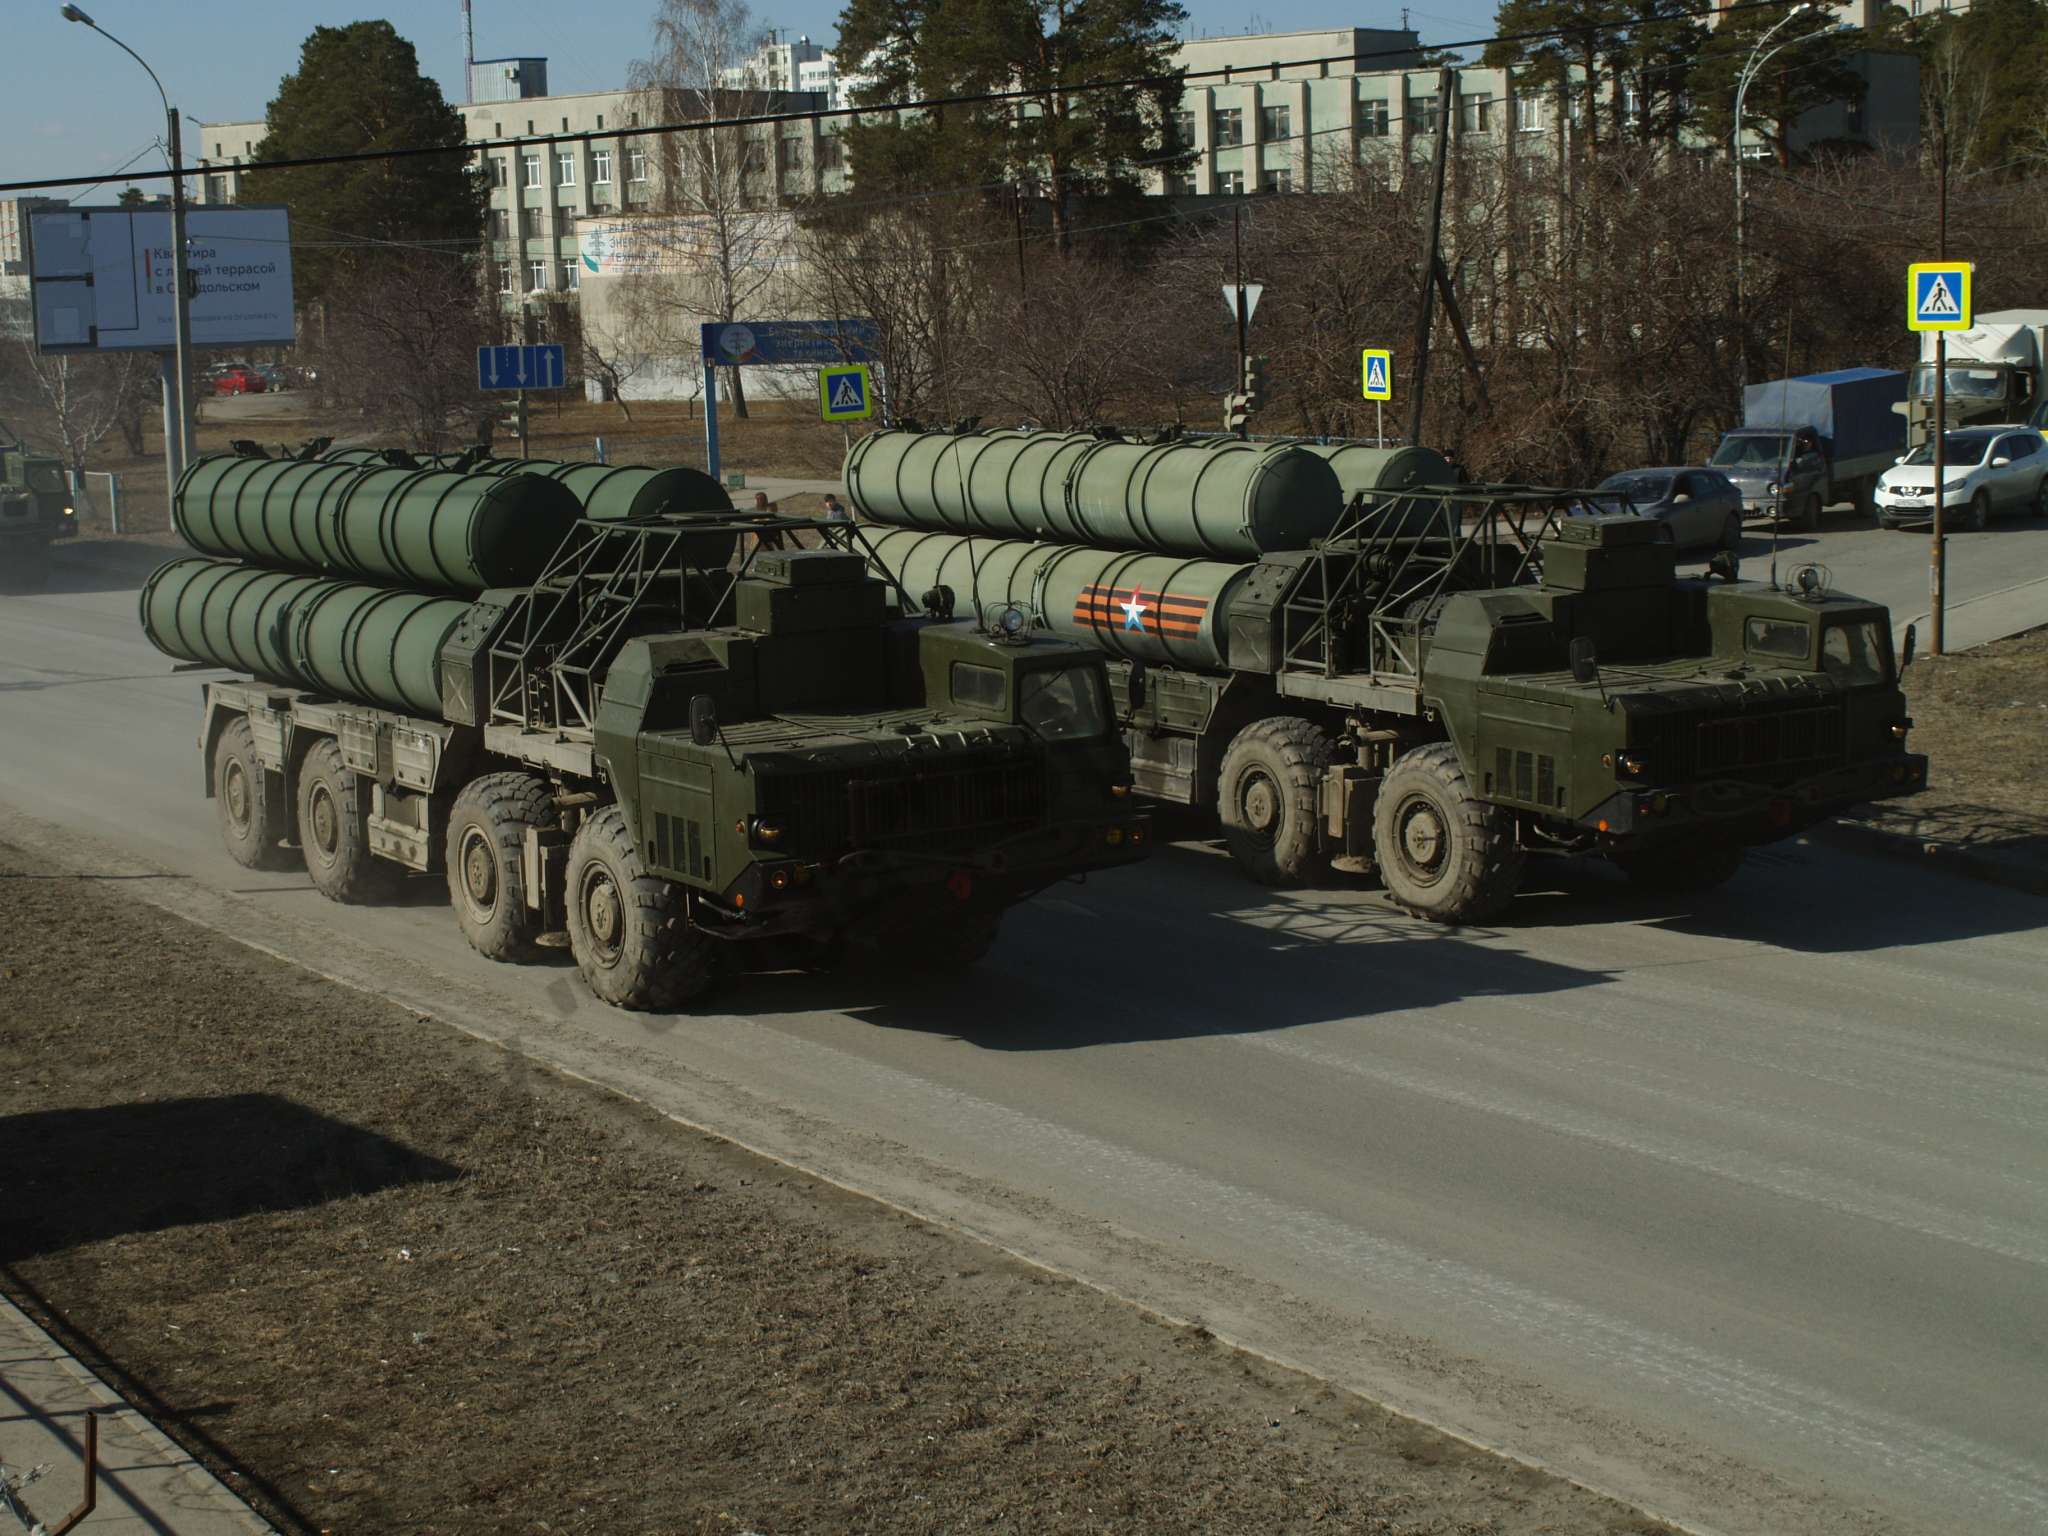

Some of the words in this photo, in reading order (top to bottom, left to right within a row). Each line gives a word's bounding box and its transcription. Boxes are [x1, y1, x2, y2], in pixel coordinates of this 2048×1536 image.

[153, 248, 217, 261] Кватира
[154, 267, 163, 277] с
[215, 262, 276, 276] террасой
[156, 285, 164, 295] в
[166, 282, 261, 296] Сдольском
